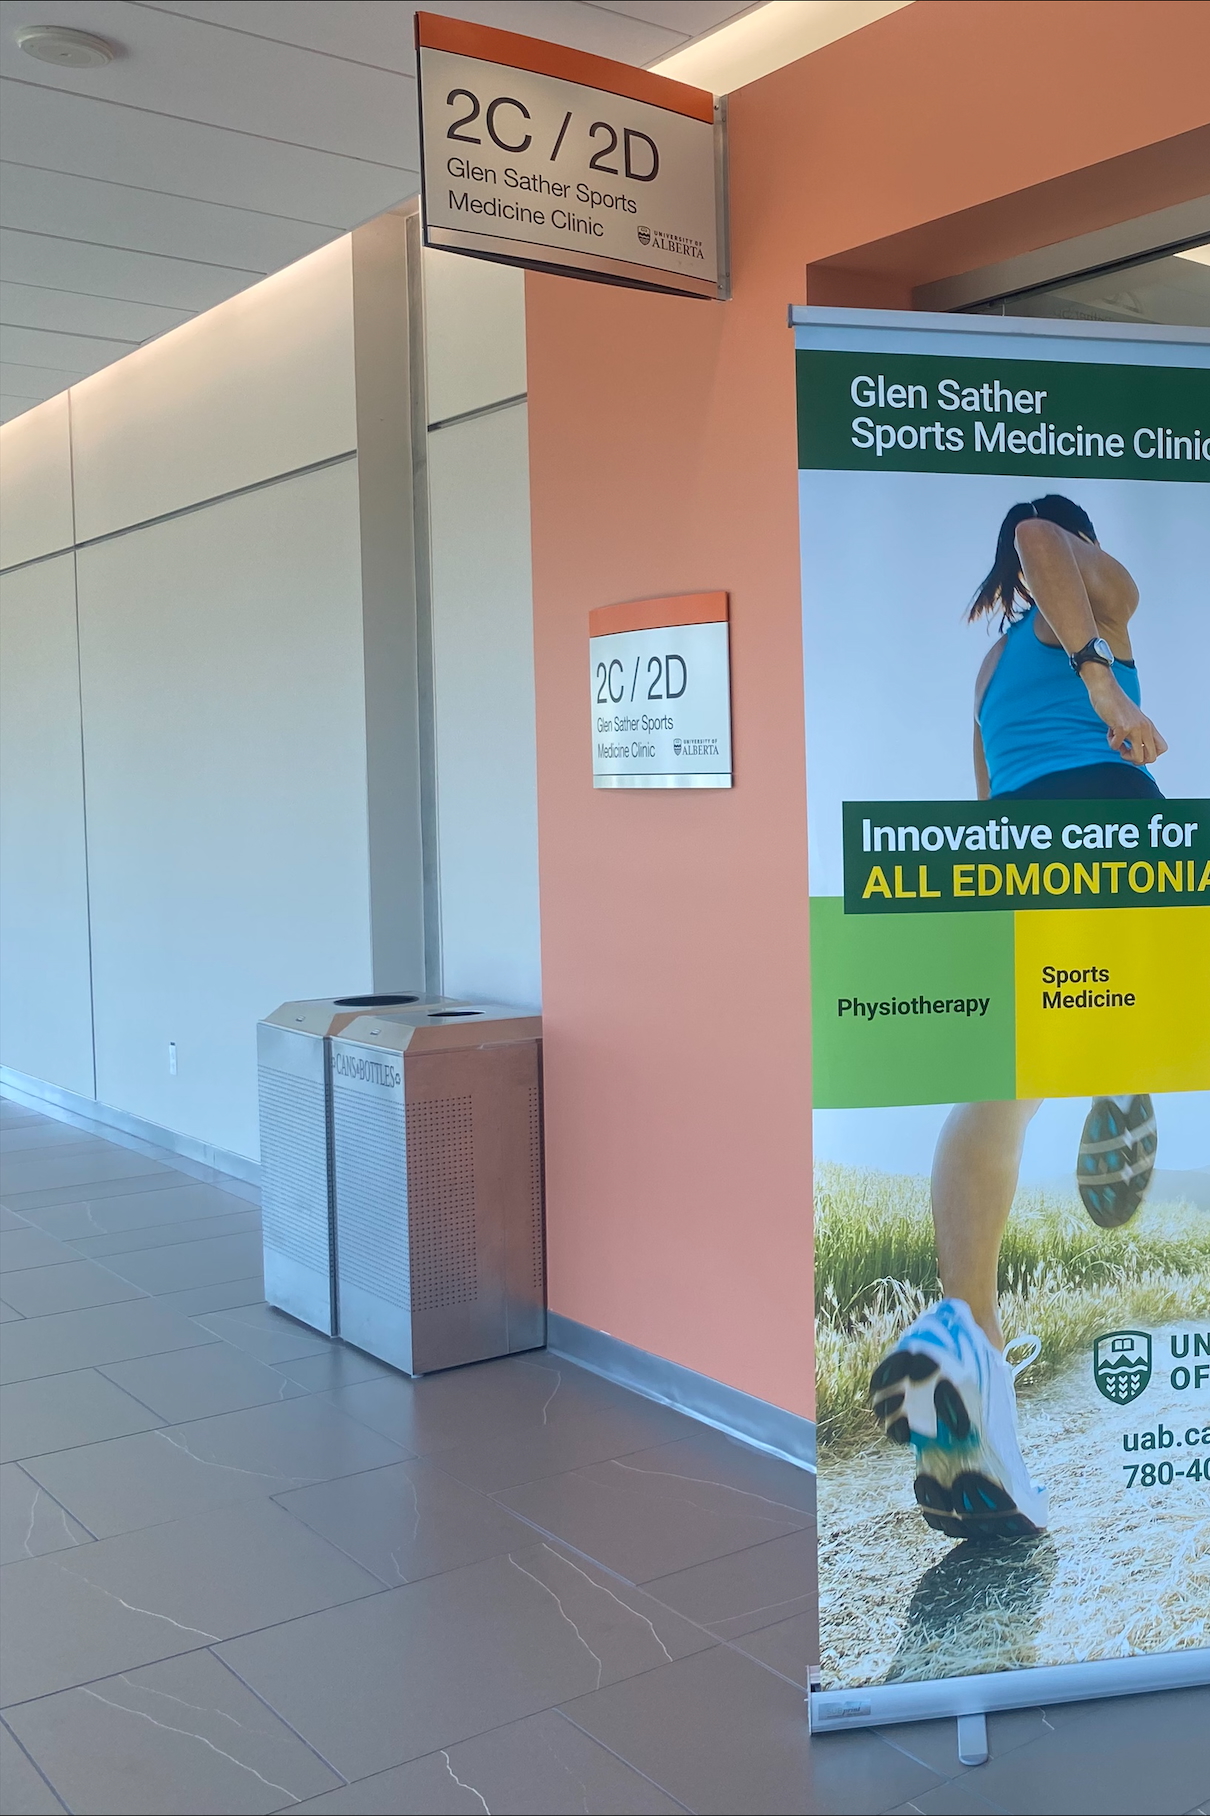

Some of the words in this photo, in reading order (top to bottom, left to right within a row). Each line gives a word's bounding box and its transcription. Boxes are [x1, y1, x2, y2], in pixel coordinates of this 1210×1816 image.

[446, 88, 532, 153] 2C
[550, 111, 572, 161] /
[588, 121, 659, 183] 2D
[446, 157, 497, 185] Glen
[503, 168, 571, 198] Sather
[576, 183, 637, 214] Sports
[449, 189, 545, 225] Medicine
[551, 208, 604, 237] Clinic
[652, 237, 705, 259] ALBERTA
[654, 230, 693, 244] UNIVERSITY
[850, 374, 928, 410] Glen
[937, 379, 1047, 415] Sather
[851, 416, 964, 457] Sports
[974, 422, 1124, 459] Medicine
[596, 658, 624, 704] 2C
[630, 656, 640, 702] /
[647, 654, 688, 700] 2D
[597, 717, 612, 733] Glen
[614, 715, 639, 732] Sather
[641, 714, 673, 734] Sports
[597, 742, 629, 759] Medicine
[631, 741, 656, 758] Clinic
[682, 744, 720, 756] ALBERTA
[862, 817, 1052, 853] Innovative
[1061, 822, 1140, 850] care
[1147, 813, 1197, 848] for
[862, 865, 941, 900] ALL
[1042, 964, 1110, 988] Sports
[837, 994, 991, 1022] Physiotherapy
[1042, 988, 1136, 1011] Medicine
[1170, 1364, 1210, 1390] OF
